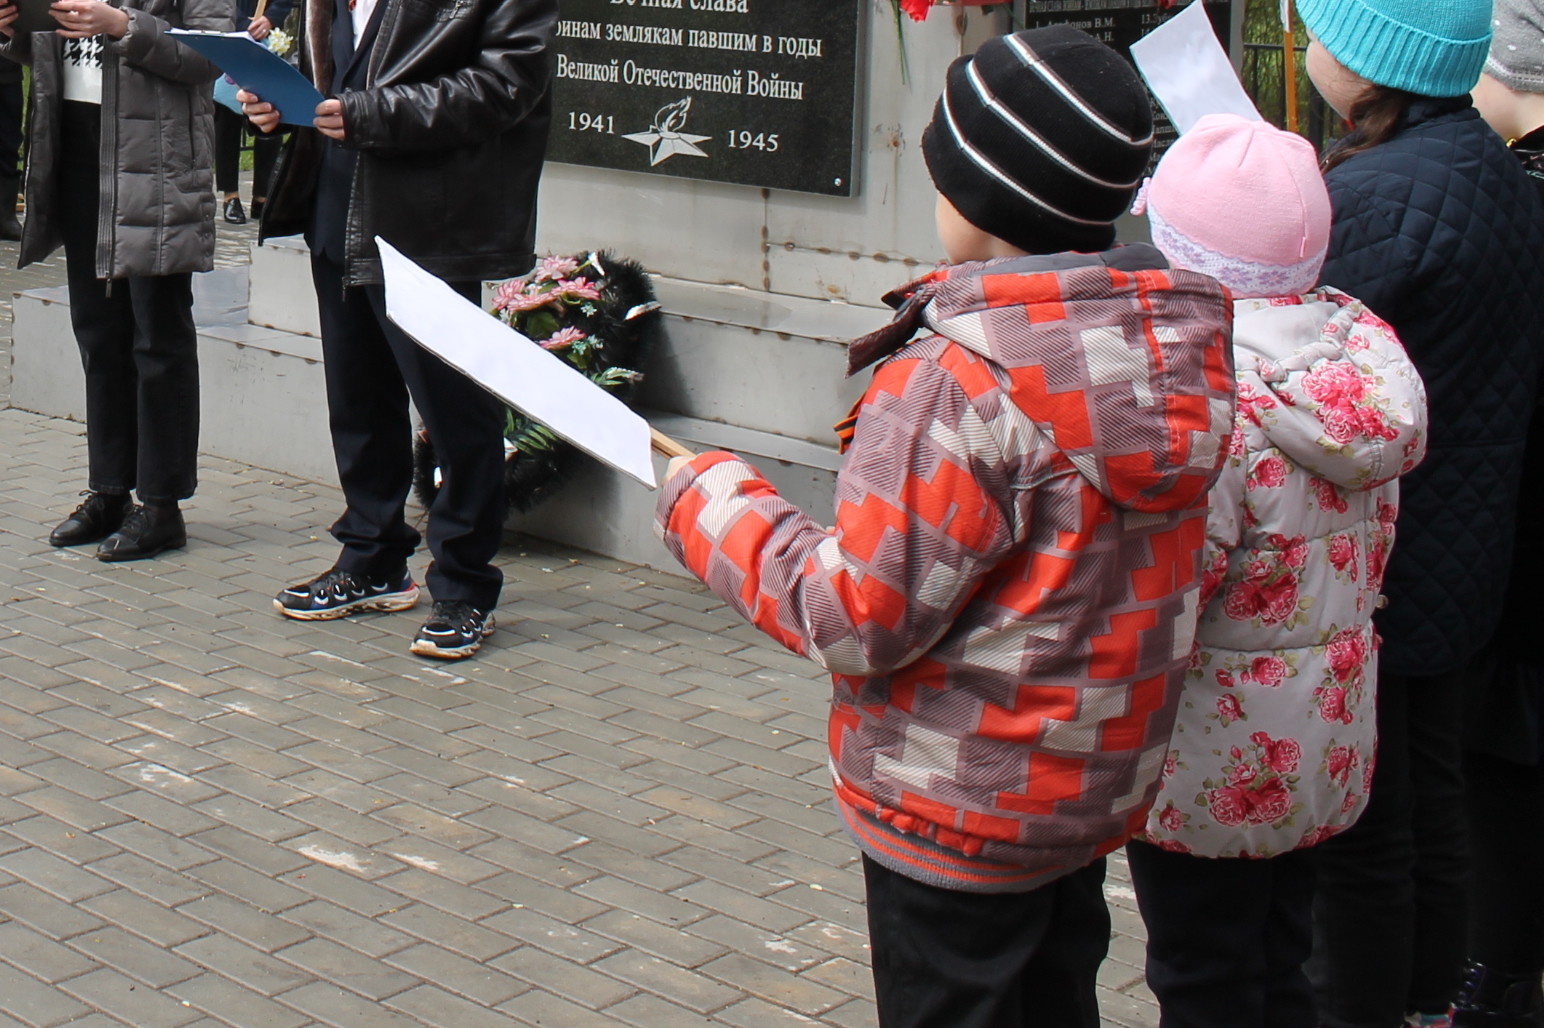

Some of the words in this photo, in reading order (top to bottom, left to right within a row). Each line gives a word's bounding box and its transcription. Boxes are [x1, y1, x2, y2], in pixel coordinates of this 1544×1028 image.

[606, 24, 683, 47] землякам
[688, 29, 757, 52] павшим
[763, 35, 772, 53] в
[778, 36, 822, 59] годы
[557, 54, 619, 83] Великой
[623, 59, 742, 95] Отечественной
[746, 70, 803, 100] Войны
[568, 111, 615, 134] 1941
[728, 129, 779, 152] 1945
